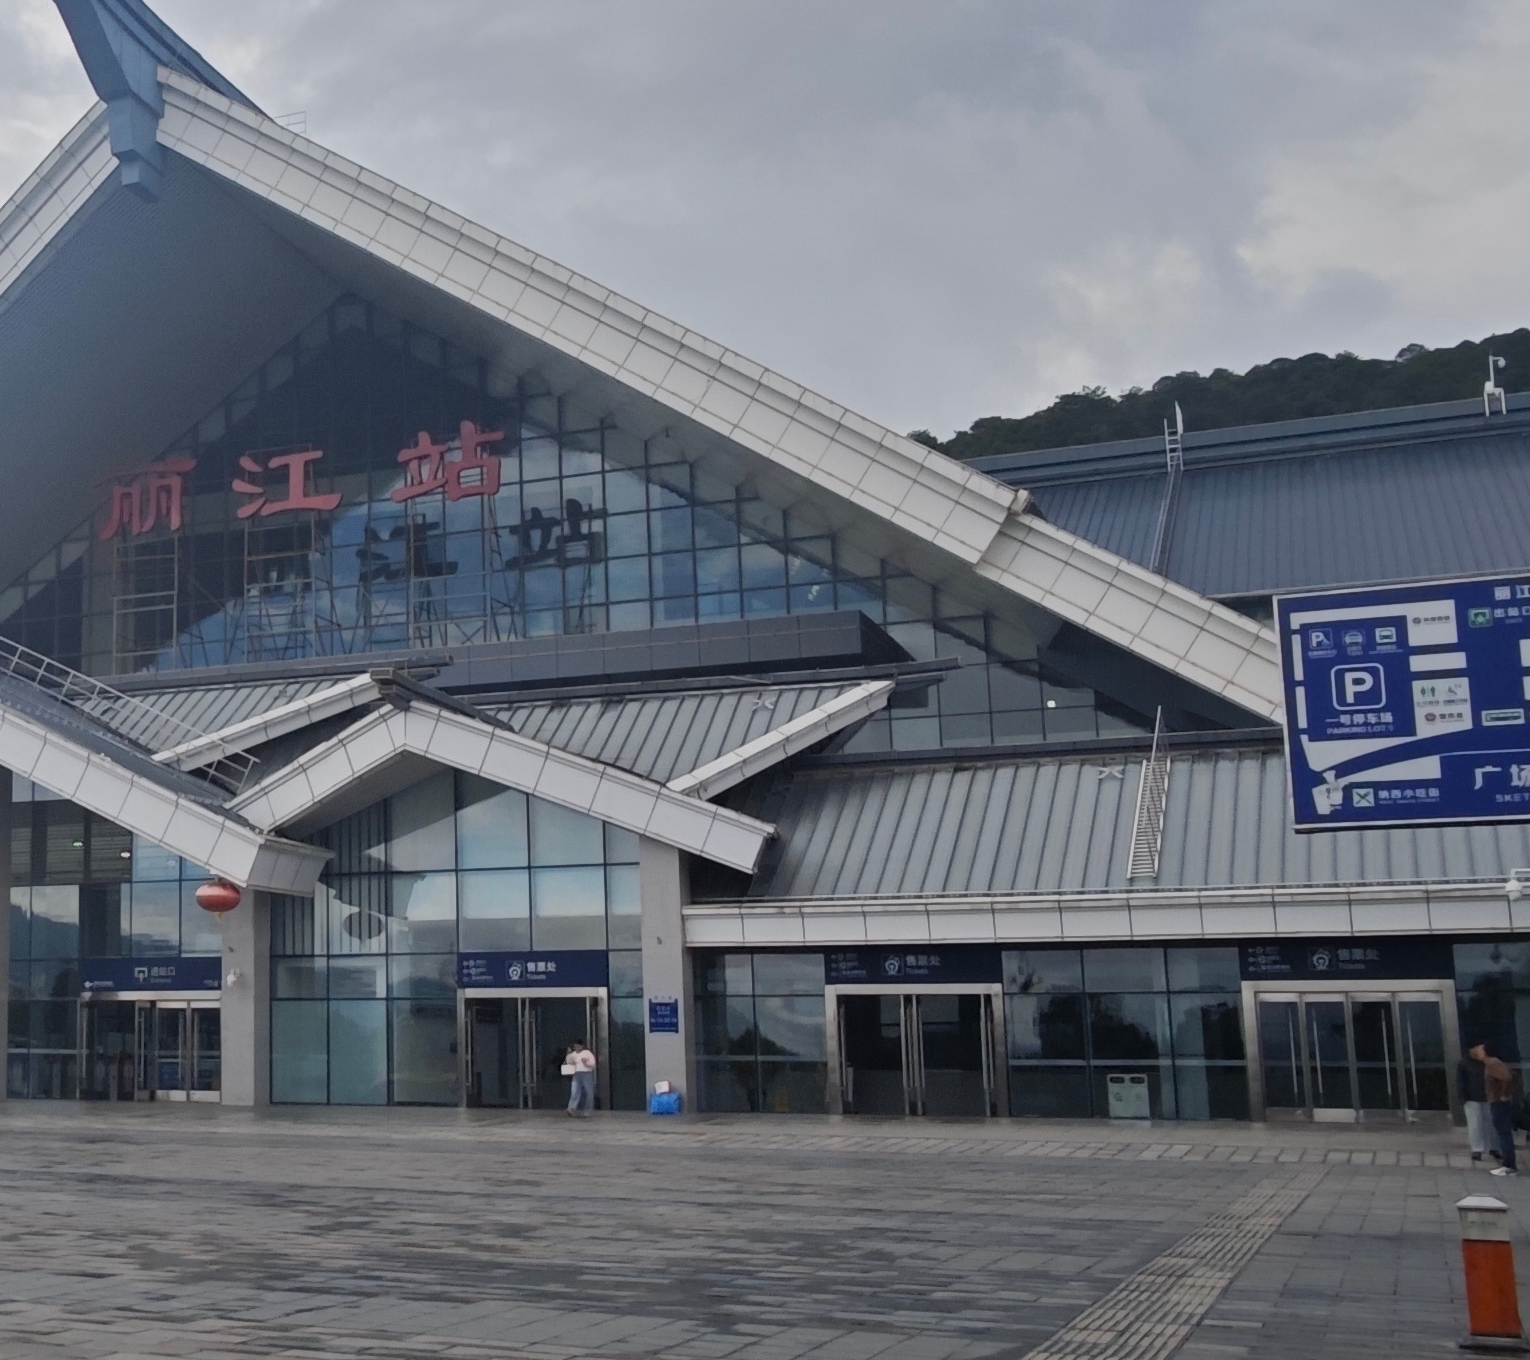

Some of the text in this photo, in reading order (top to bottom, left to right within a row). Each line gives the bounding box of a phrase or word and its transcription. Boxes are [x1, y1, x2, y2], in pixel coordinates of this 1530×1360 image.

[94, 420, 506, 541] 丽江站
[1325, 712, 1393, 726] 一号停车场
[527, 961, 556, 972] 售票处
